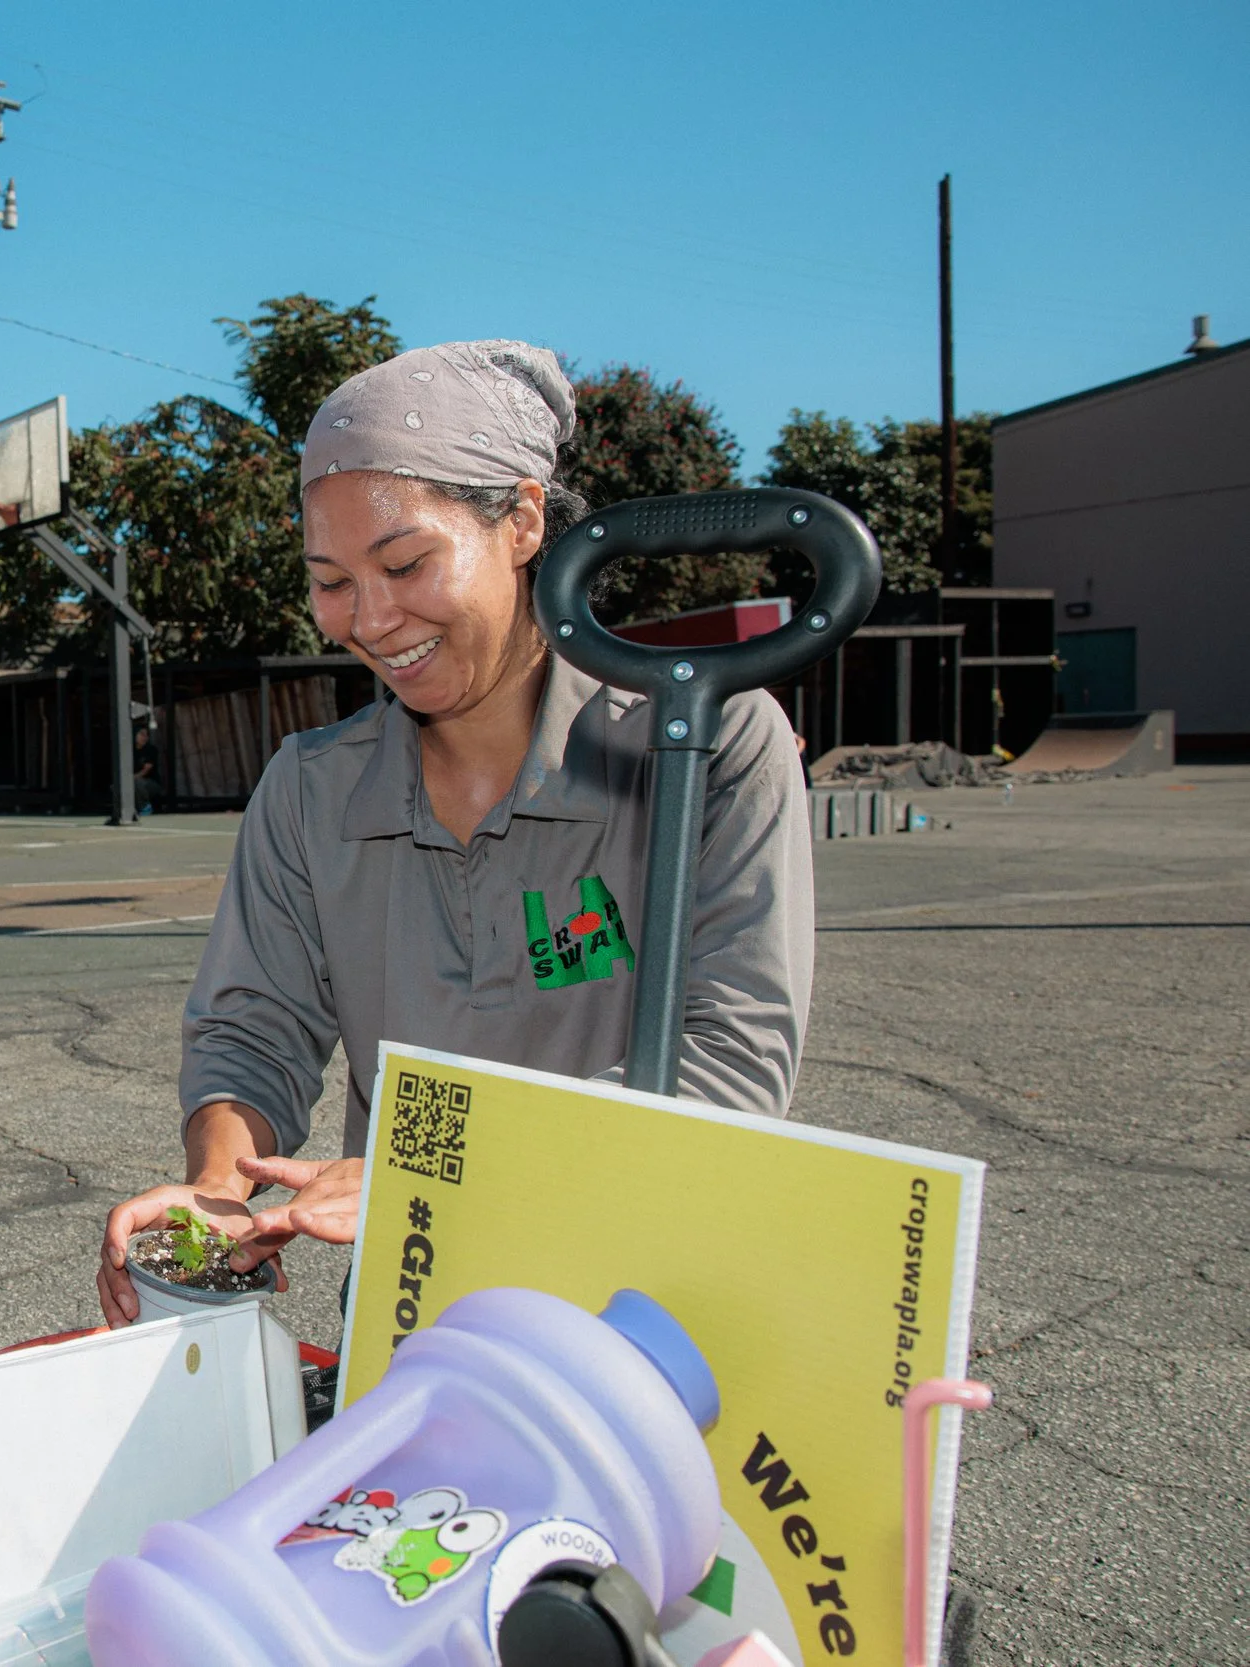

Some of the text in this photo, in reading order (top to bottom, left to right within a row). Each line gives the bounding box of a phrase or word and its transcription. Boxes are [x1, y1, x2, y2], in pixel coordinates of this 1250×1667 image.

[391, 1196, 434, 1358] #Gro
[886, 1177, 930, 1409] cropswapla.org
[741, 1431, 857, 1657] We're
